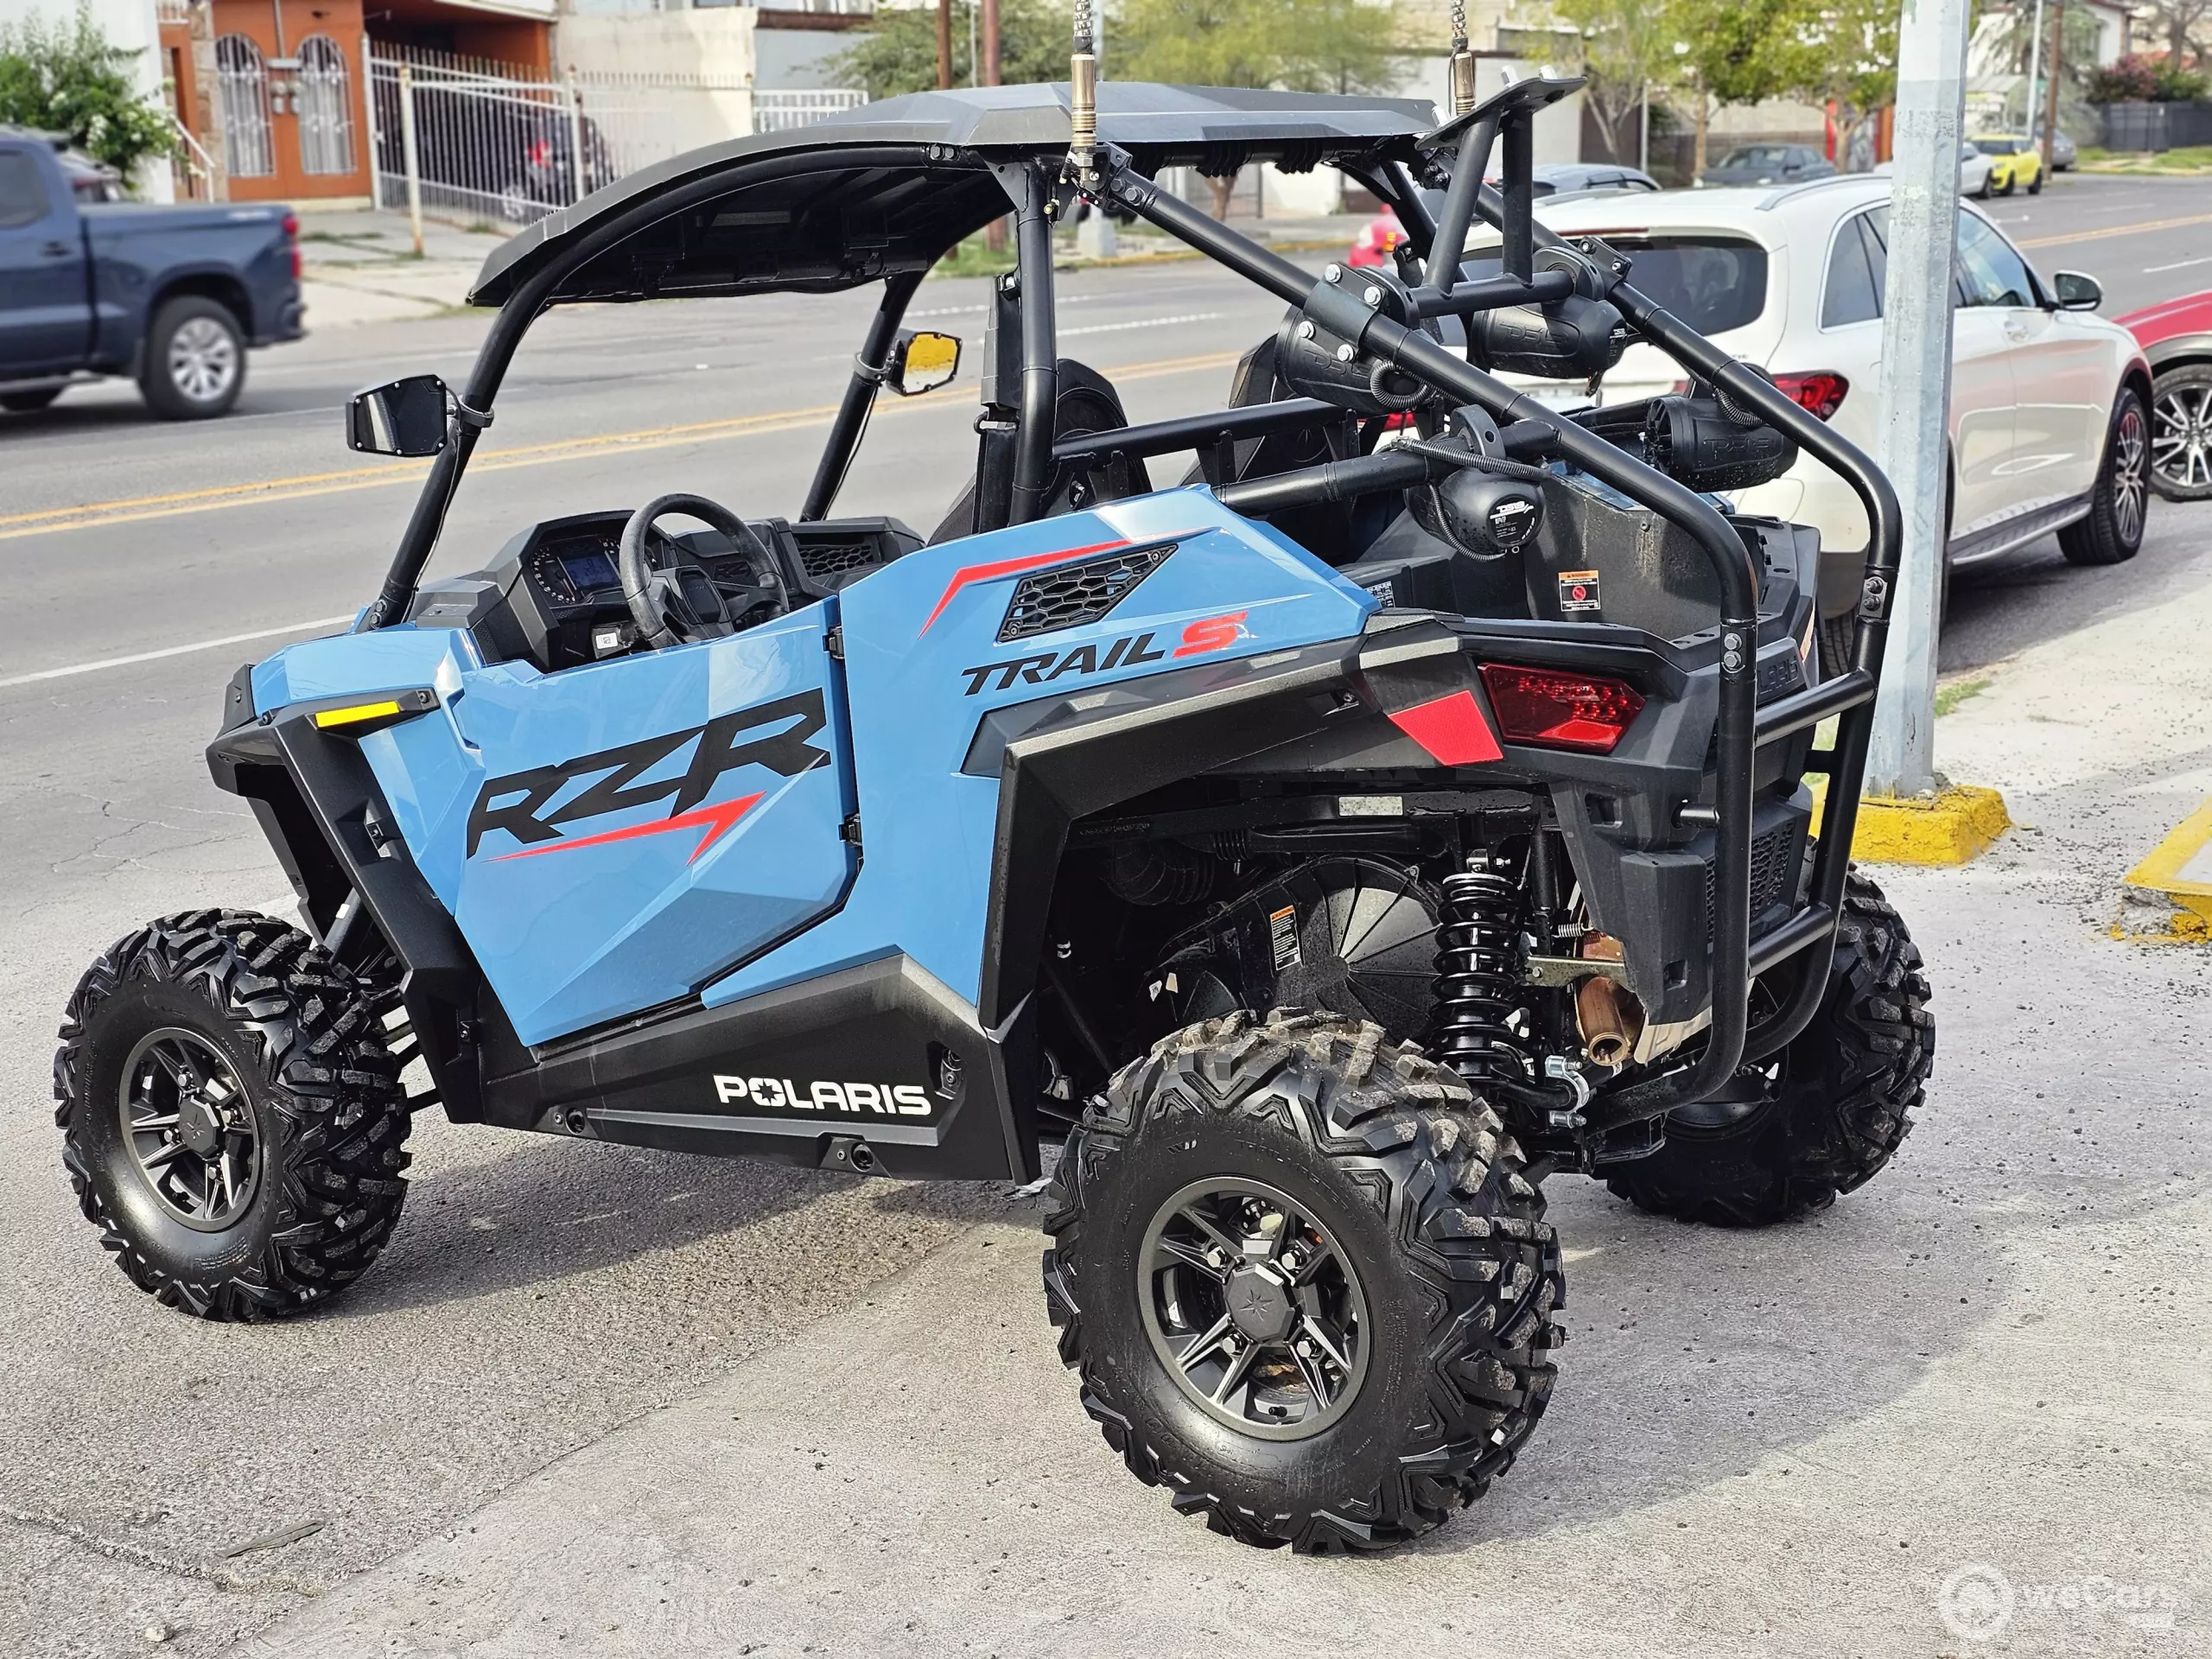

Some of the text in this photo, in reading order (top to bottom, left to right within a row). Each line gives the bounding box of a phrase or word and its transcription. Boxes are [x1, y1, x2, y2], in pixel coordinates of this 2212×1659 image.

[1499, 321, 1569, 349] DS18
[1496, 501, 1526, 514] DS18
[962, 610, 1249, 696] TRAIL S
[1757, 655, 1800, 696] LARIS
[467, 687, 832, 860] RZR
[713, 1074, 932, 1116] POLARIS
